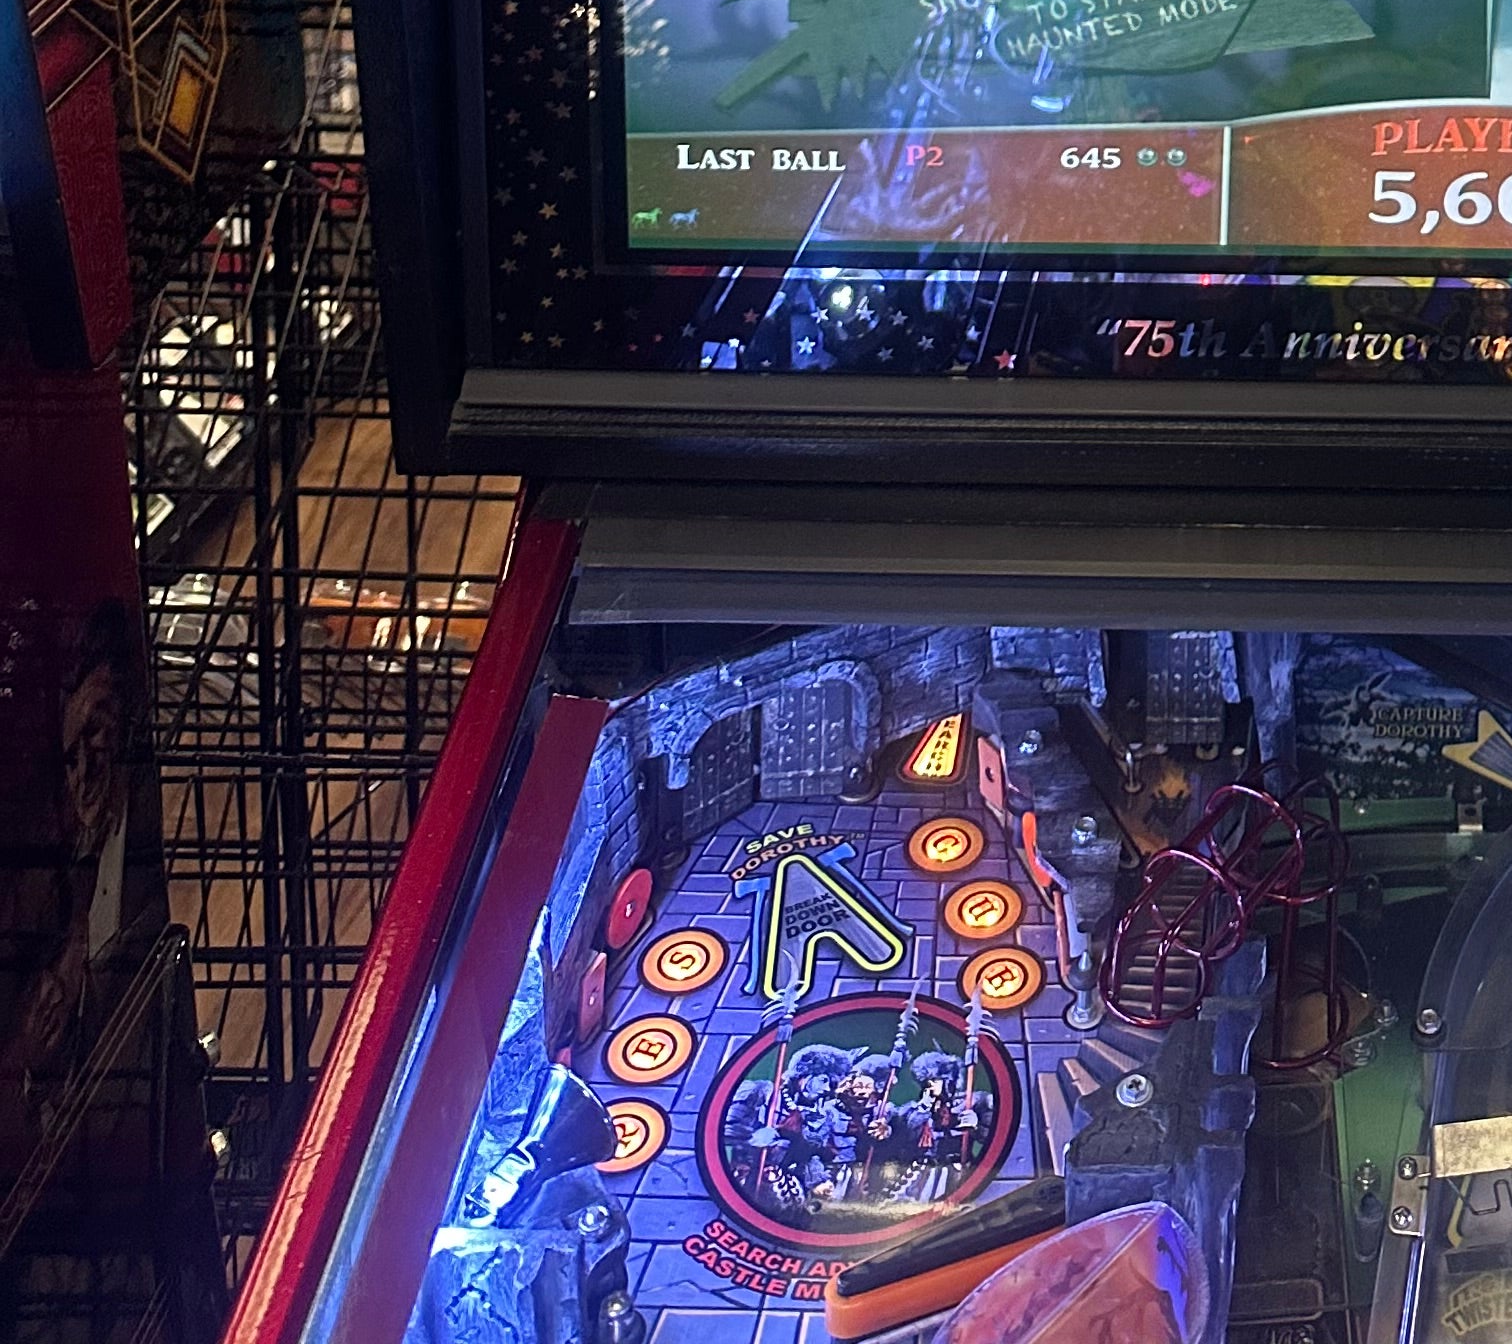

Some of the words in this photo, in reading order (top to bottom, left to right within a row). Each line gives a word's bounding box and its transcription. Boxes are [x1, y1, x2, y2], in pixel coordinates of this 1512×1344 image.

[1006, 10, 1143, 59] HAUNTED
[905, 144, 944, 168] P2
[1060, 145, 1122, 170] 645
[1378, 707, 1464, 722] CAPTURE
[1375, 723, 1464, 739] DOROTHY
[745, 823, 815, 854] SAVE
[730, 834, 846, 880] DOROTHY
[784, 892, 833, 913] BREAK
[784, 899, 841, 926] DOWN
[785, 909, 850, 940] DOOR
[669, 951, 697, 970] S
[631, 1037, 666, 1061] E
[706, 1220, 801, 1275] SEARCH
[685, 1236, 787, 1296] CASTLE
